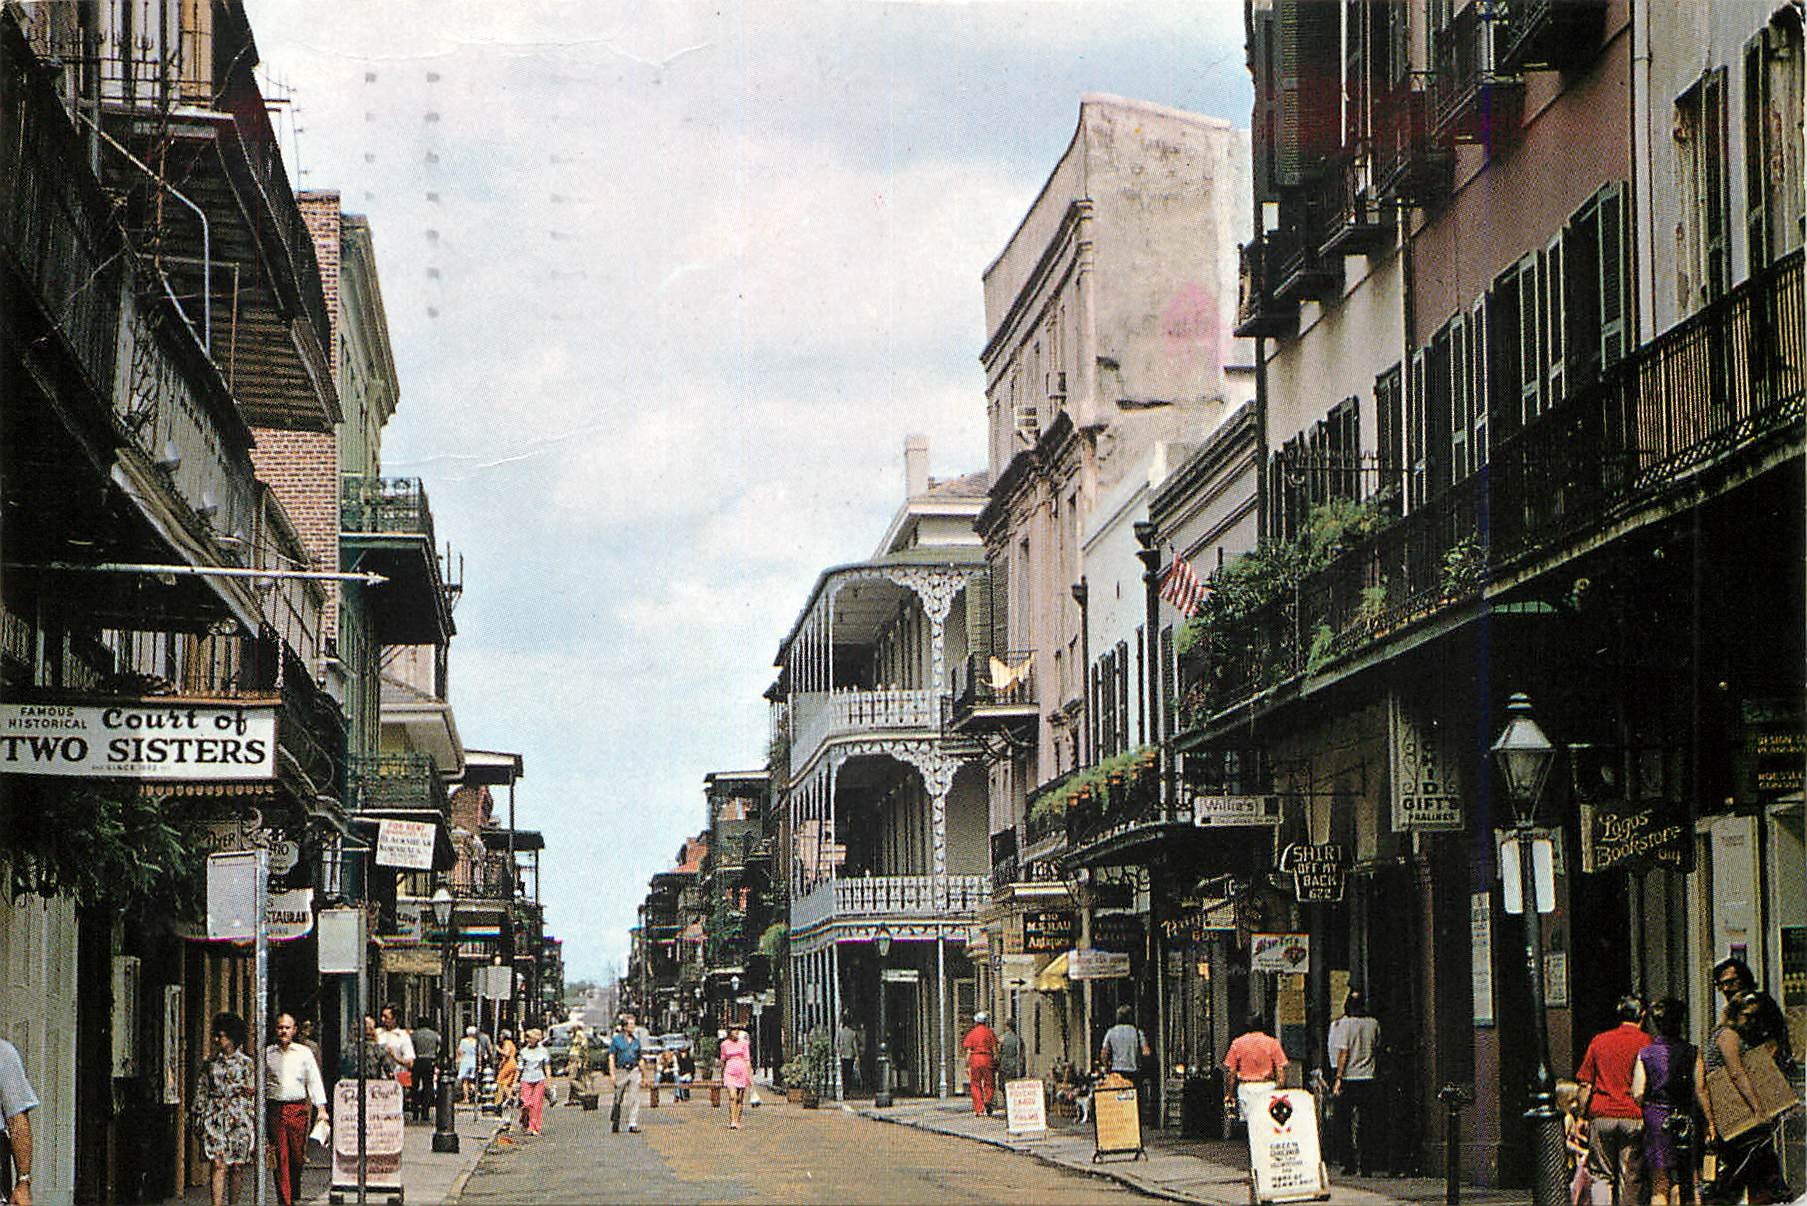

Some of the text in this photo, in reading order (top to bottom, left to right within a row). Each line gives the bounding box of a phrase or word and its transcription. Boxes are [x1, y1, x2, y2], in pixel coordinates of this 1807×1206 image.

[20, 706, 75, 717] FAMOUS
[8, 718, 88, 729] HISTORICAL
[102, 706, 248, 735] Court of
[0, 735, 266, 764] TWO SISTERS
[1599, 809, 1654, 841] Logos
[1293, 845, 1342, 862] SHIRT
[1595, 826, 1681, 867] Bookstore
[1298, 862, 1317, 873] OFF
[1303, 875, 1337, 886] BACK
